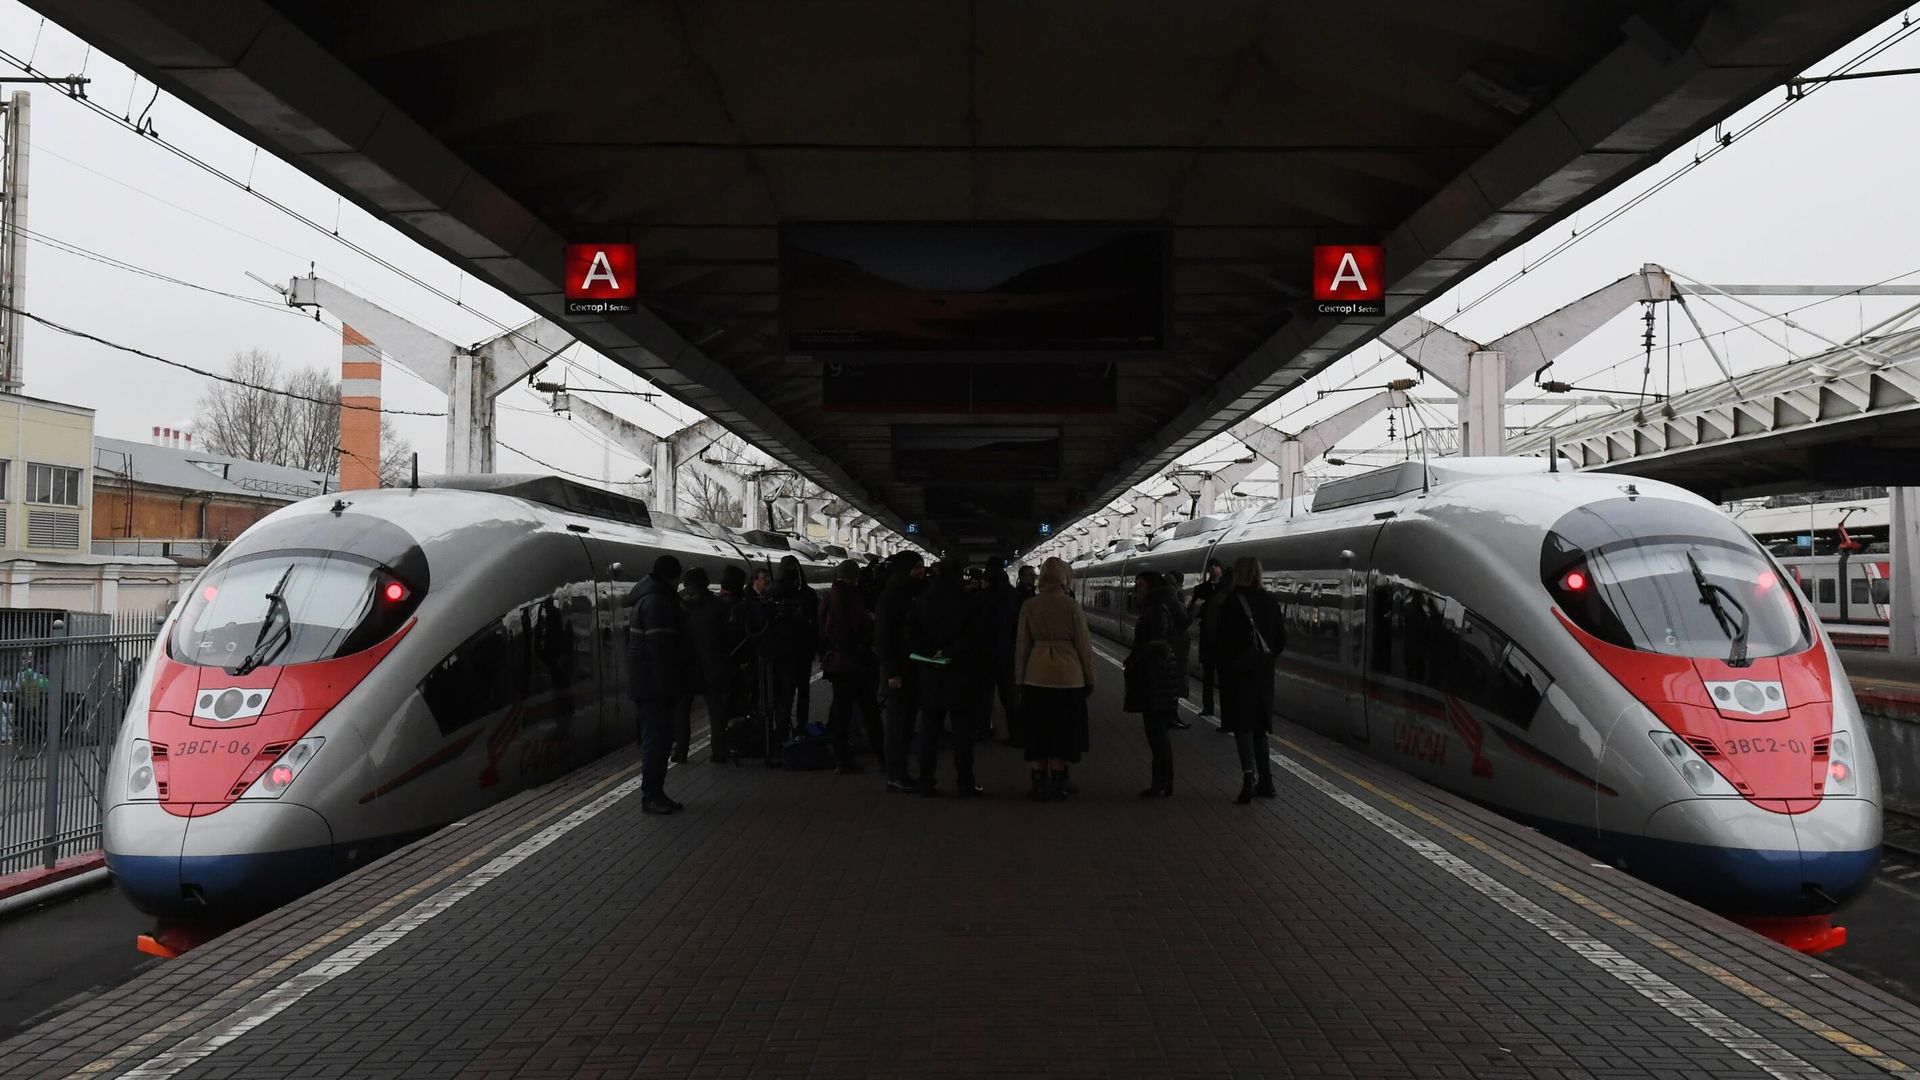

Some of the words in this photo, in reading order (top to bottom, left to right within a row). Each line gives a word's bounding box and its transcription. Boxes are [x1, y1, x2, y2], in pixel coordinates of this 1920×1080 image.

[581, 251, 620, 289] A
[1329, 252, 1368, 291] A
[570, 303, 603, 313] Сектор
[609, 304, 630, 312] Sector
[1318, 304, 1352, 315] Сектор
[1358, 305, 1380, 313] Sector
